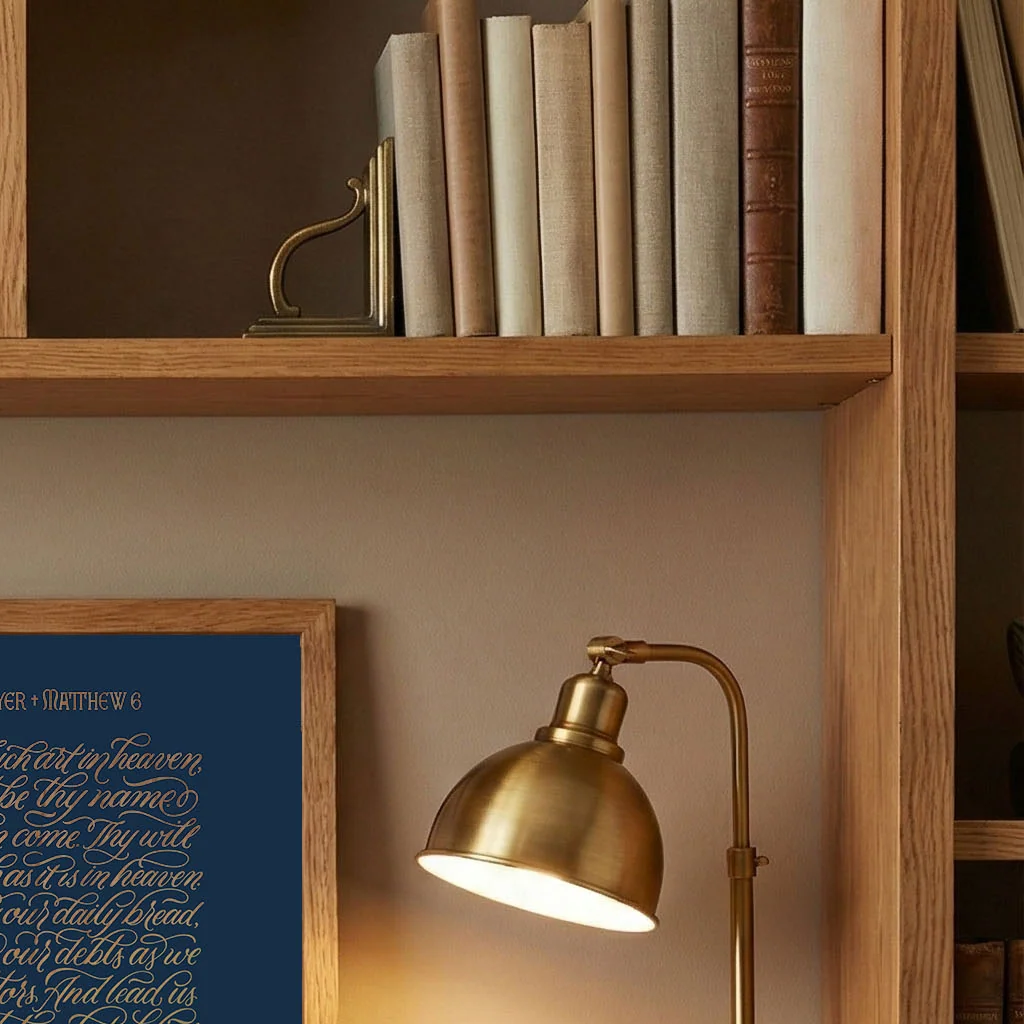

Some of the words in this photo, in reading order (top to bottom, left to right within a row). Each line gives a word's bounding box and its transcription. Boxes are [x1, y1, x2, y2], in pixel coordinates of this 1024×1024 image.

[42, 689, 127, 710] MATTHEW
[131, 691, 142, 710] 6
[33, 743, 85, 774] art
[78, 749, 110, 784] in
[108, 733, 203, 776] heaven,
[24, 772, 88, 827] thy
[12, 828, 80, 849] come.
[63, 816, 140, 865] Thy
[118, 810, 201, 849] will
[2, 868, 34, 888] as
[57, 868, 80, 888] is
[80, 866, 110, 890] in
[110, 850, 204, 890] heaven.
[2, 900, 49, 930] our
[30, 890, 136, 942] daily
[122, 888, 204, 931] bread,
[2, 939, 51, 972] our
[163, 947, 201, 965] we
[32, 967, 113, 1012] And
[105, 970, 192, 1007] lead
[168, 986, 198, 1006] us
